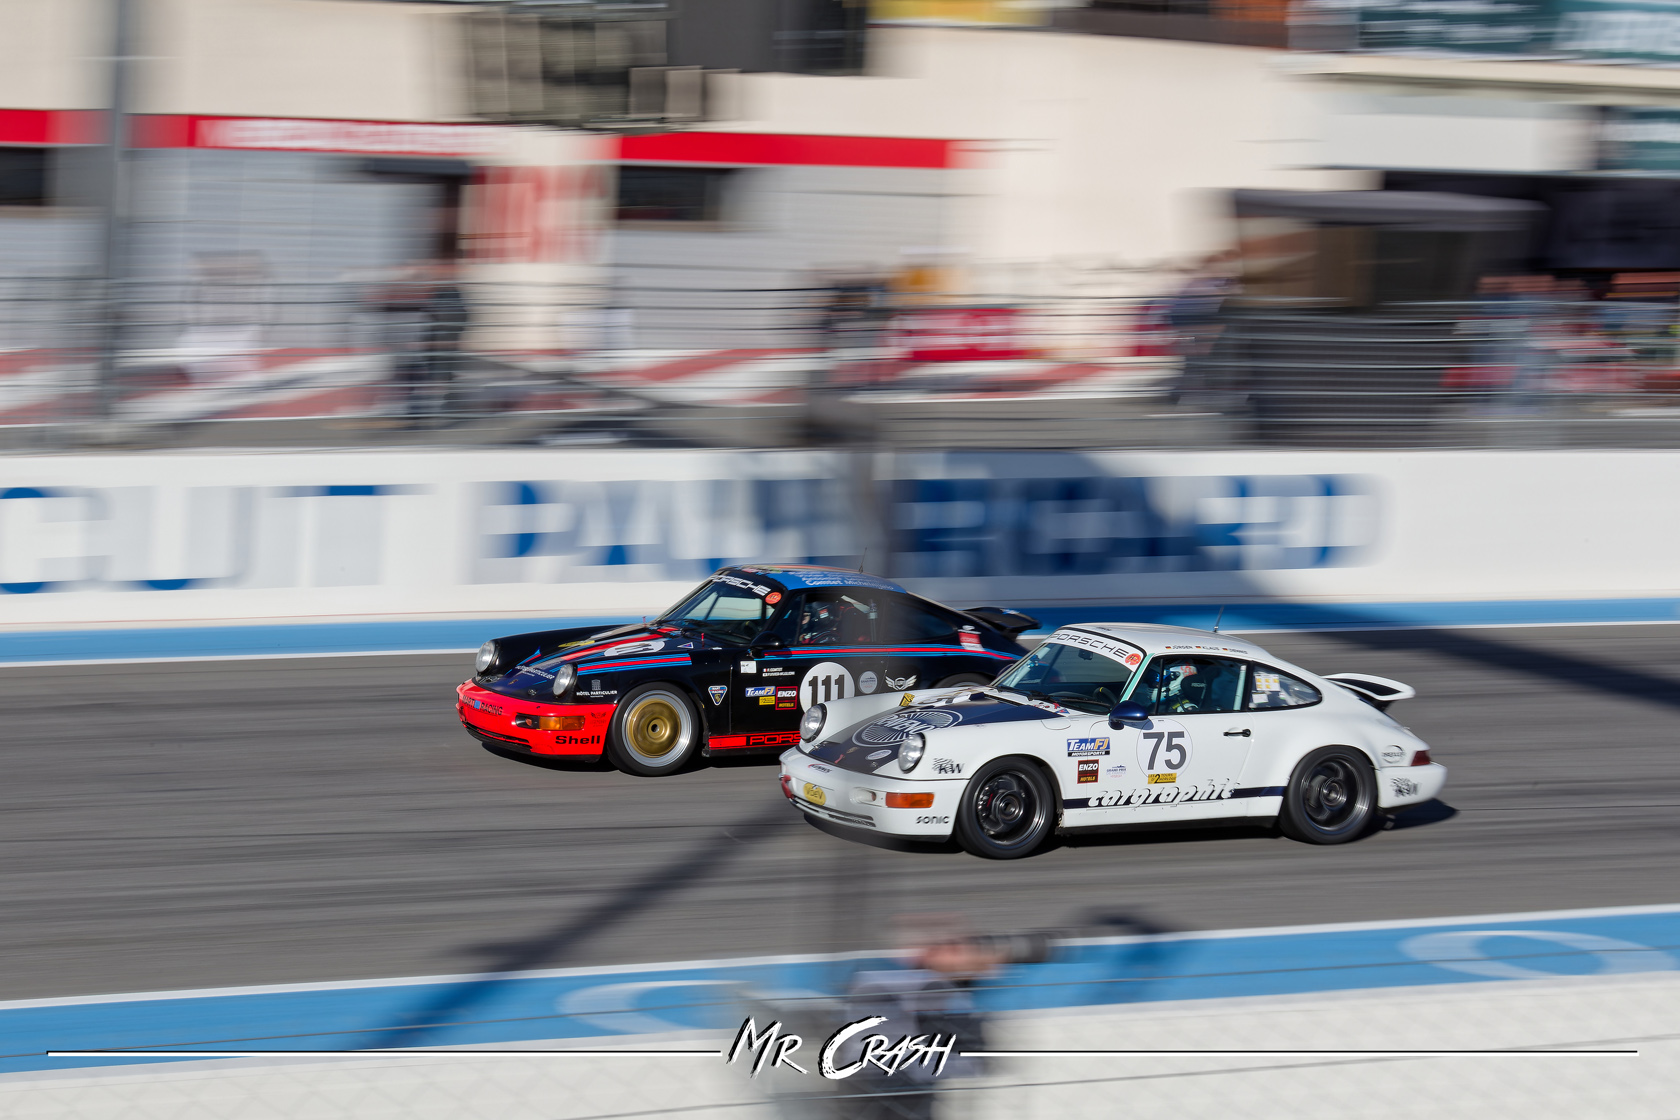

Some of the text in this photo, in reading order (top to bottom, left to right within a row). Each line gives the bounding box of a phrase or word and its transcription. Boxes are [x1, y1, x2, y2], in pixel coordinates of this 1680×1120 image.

[777, 690, 797, 698] ENZO
[808, 674, 845, 707] 111
[555, 735, 600, 745] Shell
[1142, 731, 1187, 771] 75
[1078, 762, 1099, 772] ENZO
